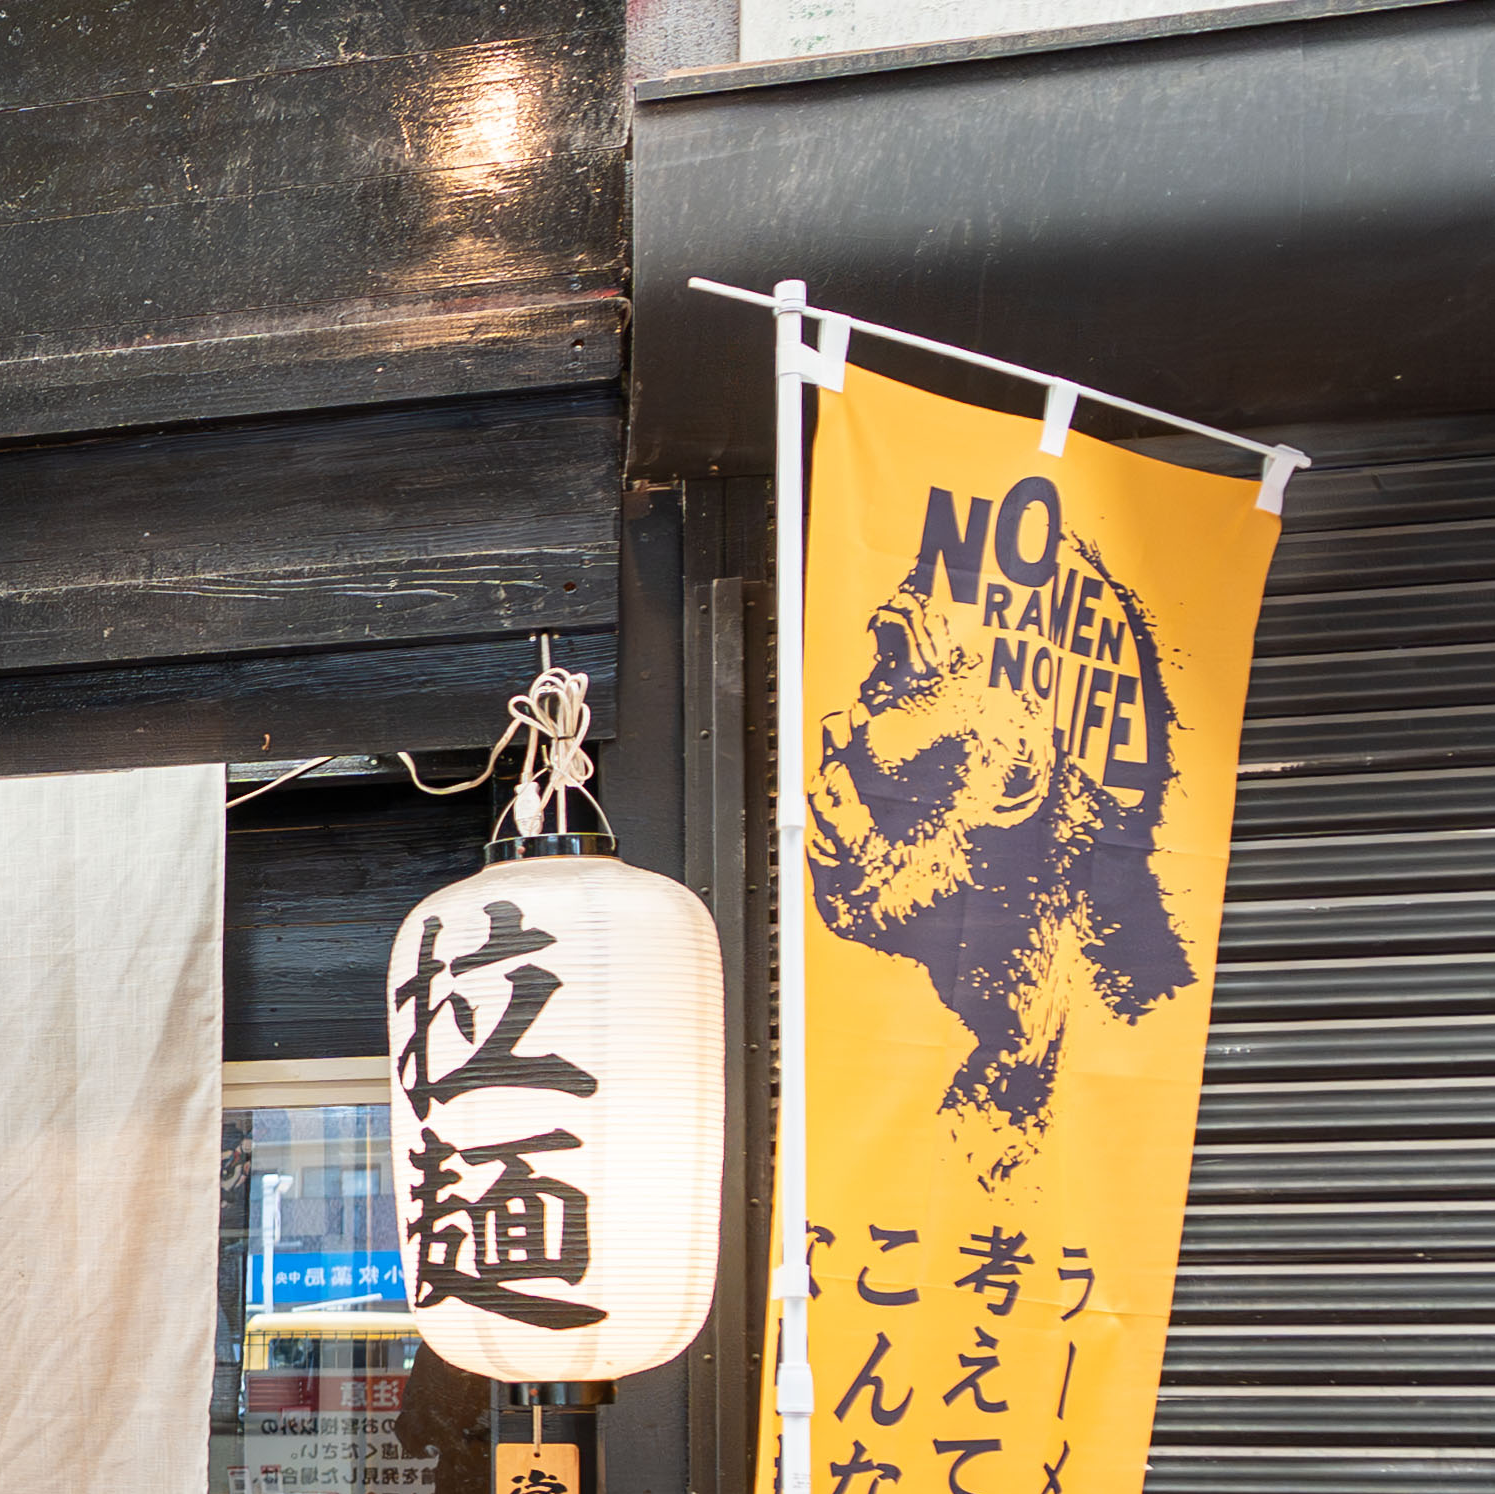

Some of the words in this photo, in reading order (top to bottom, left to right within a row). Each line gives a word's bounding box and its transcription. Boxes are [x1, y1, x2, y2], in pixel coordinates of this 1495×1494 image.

[919, 476, 1061, 604] NO
[983, 563, 1127, 665] RAMEN
[988, 637, 1053, 699] NO
[1053, 657, 1150, 792] LIFE
[395, 899, 608, 1330] 拉麺
